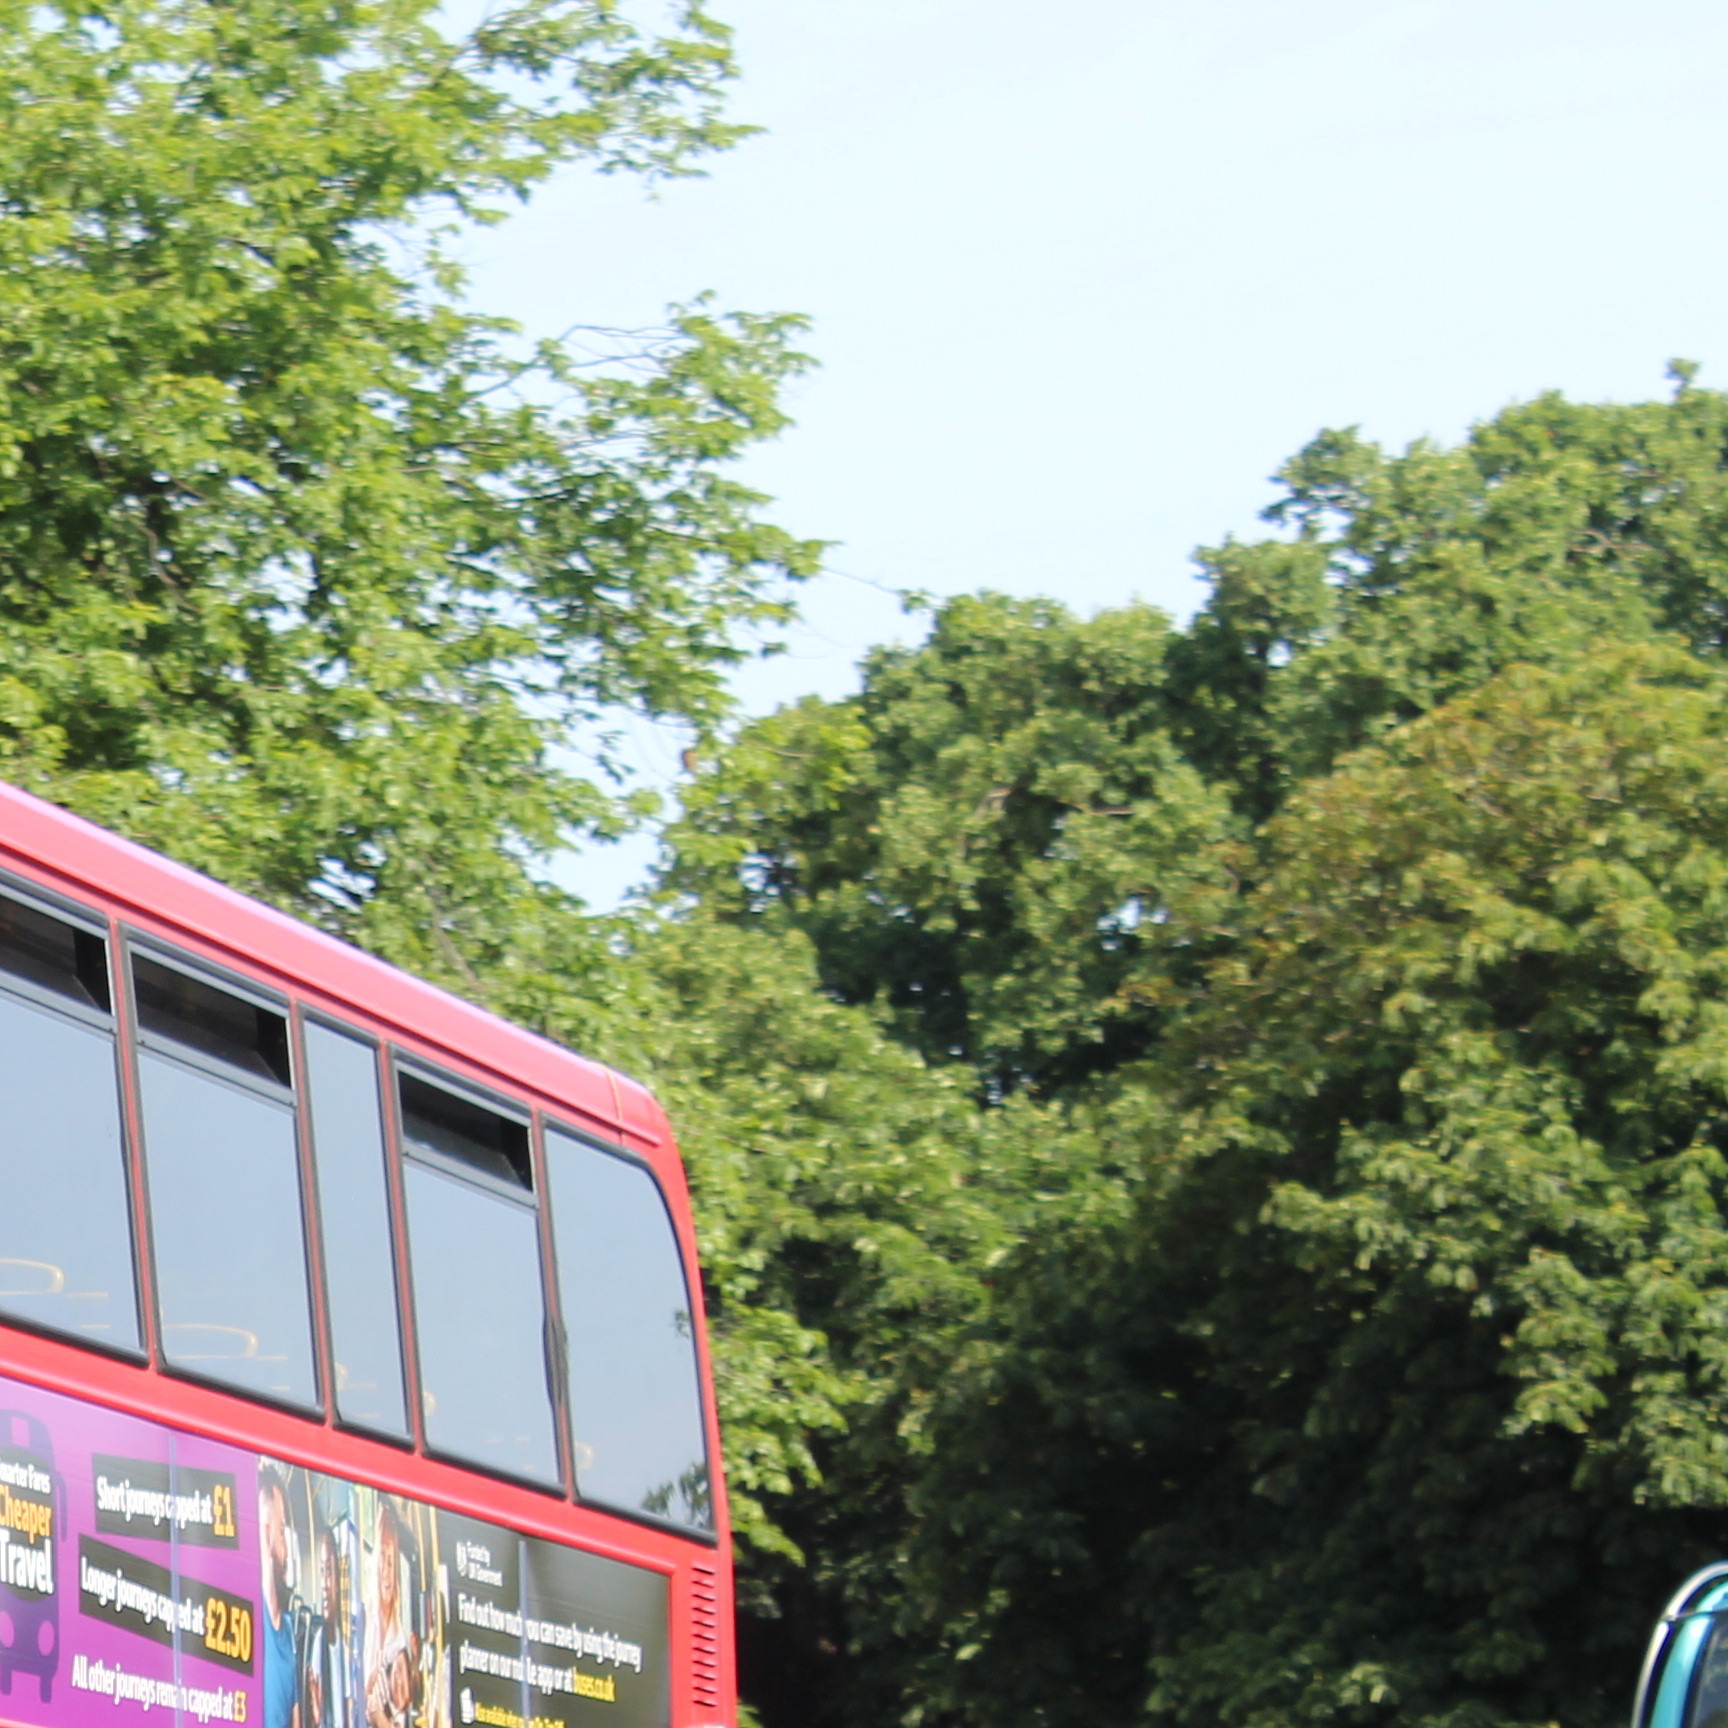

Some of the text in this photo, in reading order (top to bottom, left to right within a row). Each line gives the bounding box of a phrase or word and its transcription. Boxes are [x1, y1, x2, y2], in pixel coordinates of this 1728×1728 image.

[28, 1463, 51, 1494] Fares
[96, 1475, 125, 1512] Short
[125, 1479, 164, 1526] journeys
[200, 1494, 213, 1524] at
[213, 1484, 236, 1537] £1
[80, 1556, 116, 1607] Longer
[115, 1568, 157, 1624] journeys
[192, 1604, 204, 1636] at
[204, 1597, 252, 1662] £2.50
[458, 1593, 476, 1624] Find
[71, 1655, 247, 1724] All other journeys reman capped at £3
